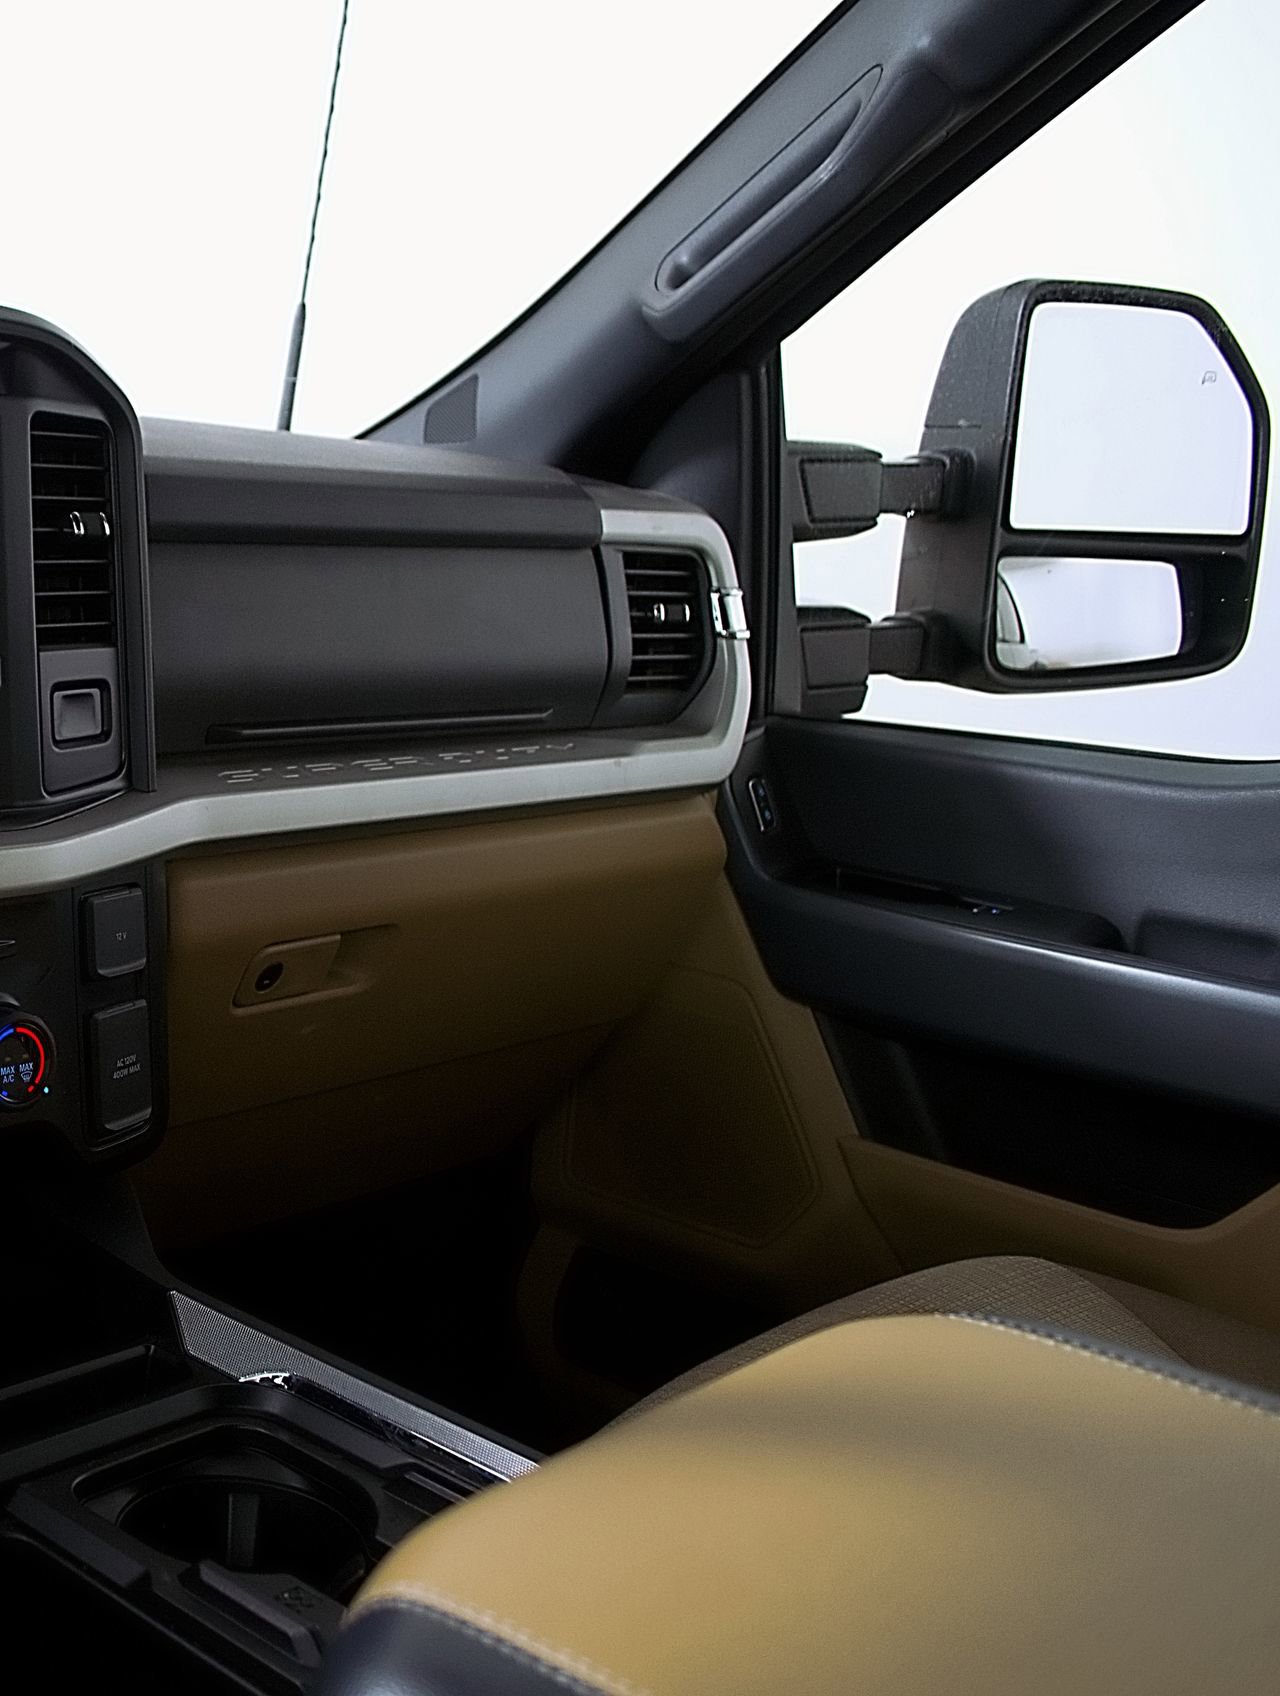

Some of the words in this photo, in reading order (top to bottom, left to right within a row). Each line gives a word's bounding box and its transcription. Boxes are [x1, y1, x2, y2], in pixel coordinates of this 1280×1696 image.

[0, 1065, 16, 1076] MAX
[20, 1061, 34, 1073] MAX
[3, 1074, 15, 1085] A/C
